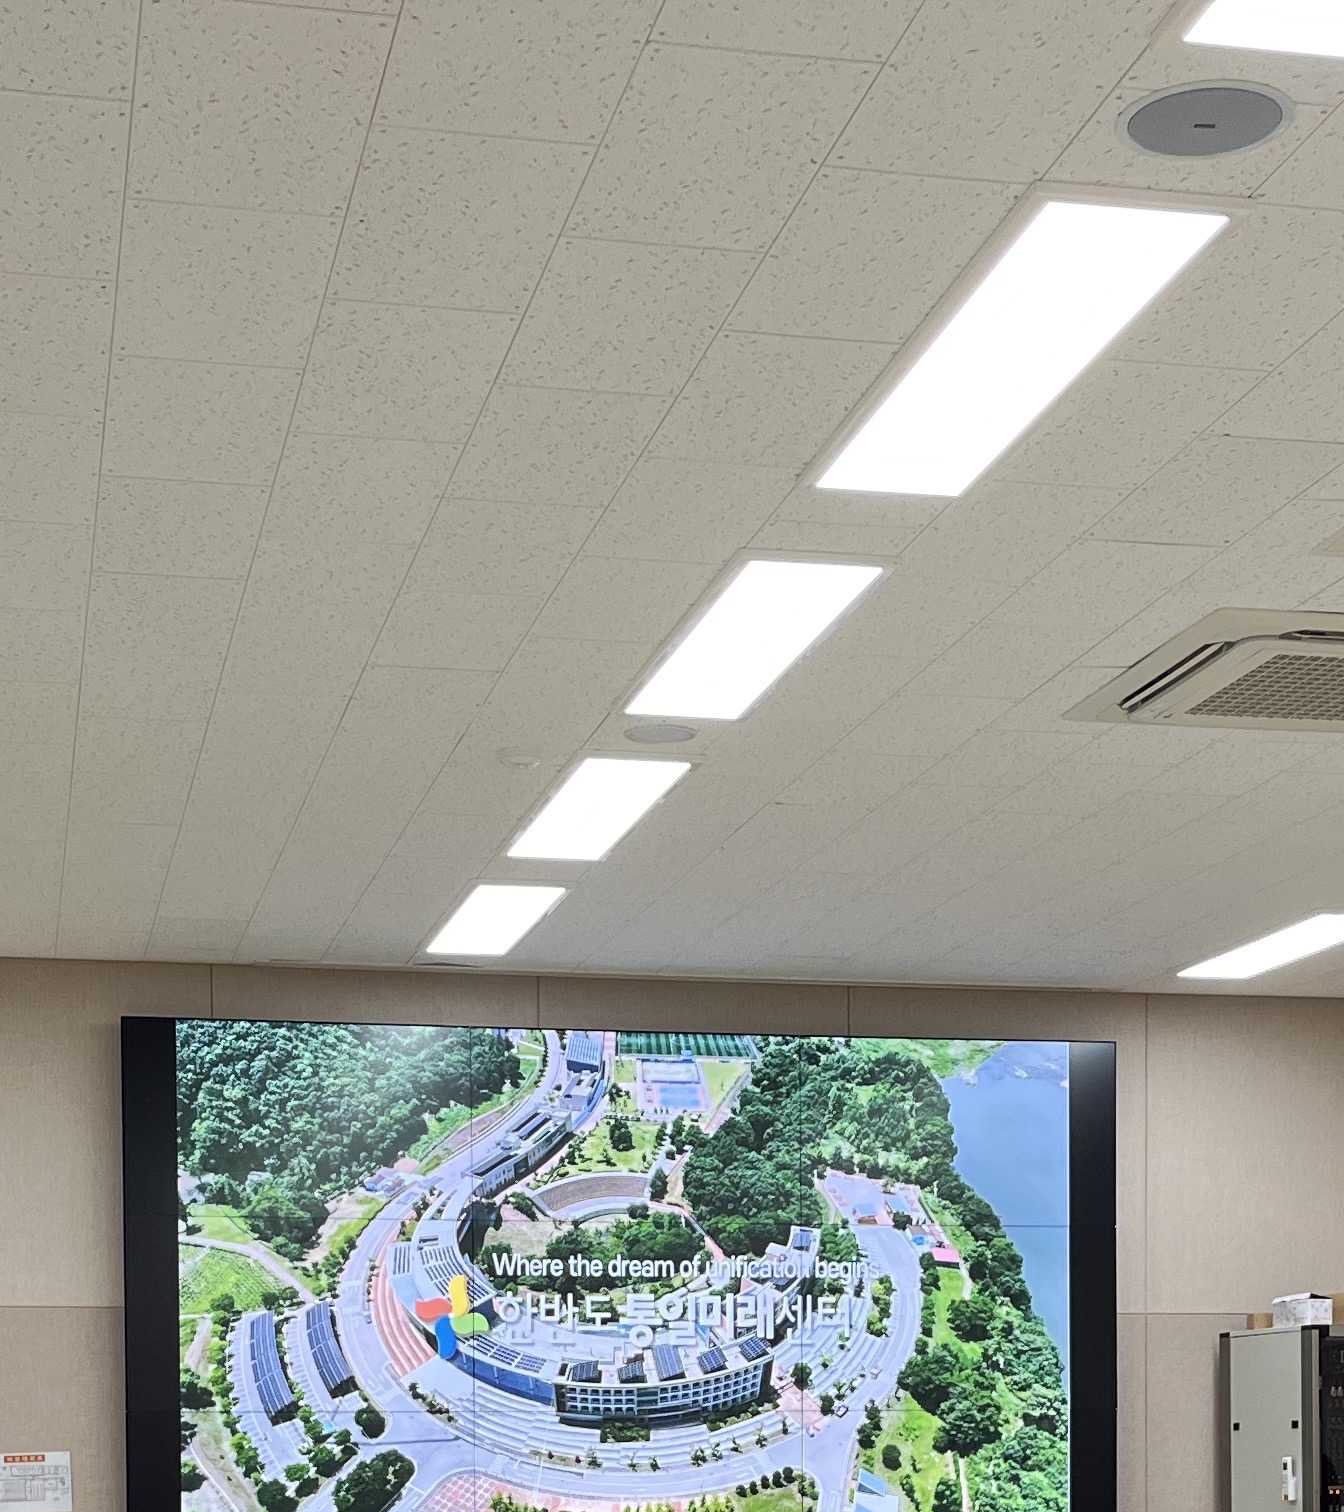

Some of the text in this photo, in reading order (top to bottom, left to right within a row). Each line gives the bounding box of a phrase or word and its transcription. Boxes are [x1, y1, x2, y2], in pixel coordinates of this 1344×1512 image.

[492, 1252, 880, 1284] Where the dream of unification begins
[497, 1290, 851, 1348] 한반도통일미래센터
